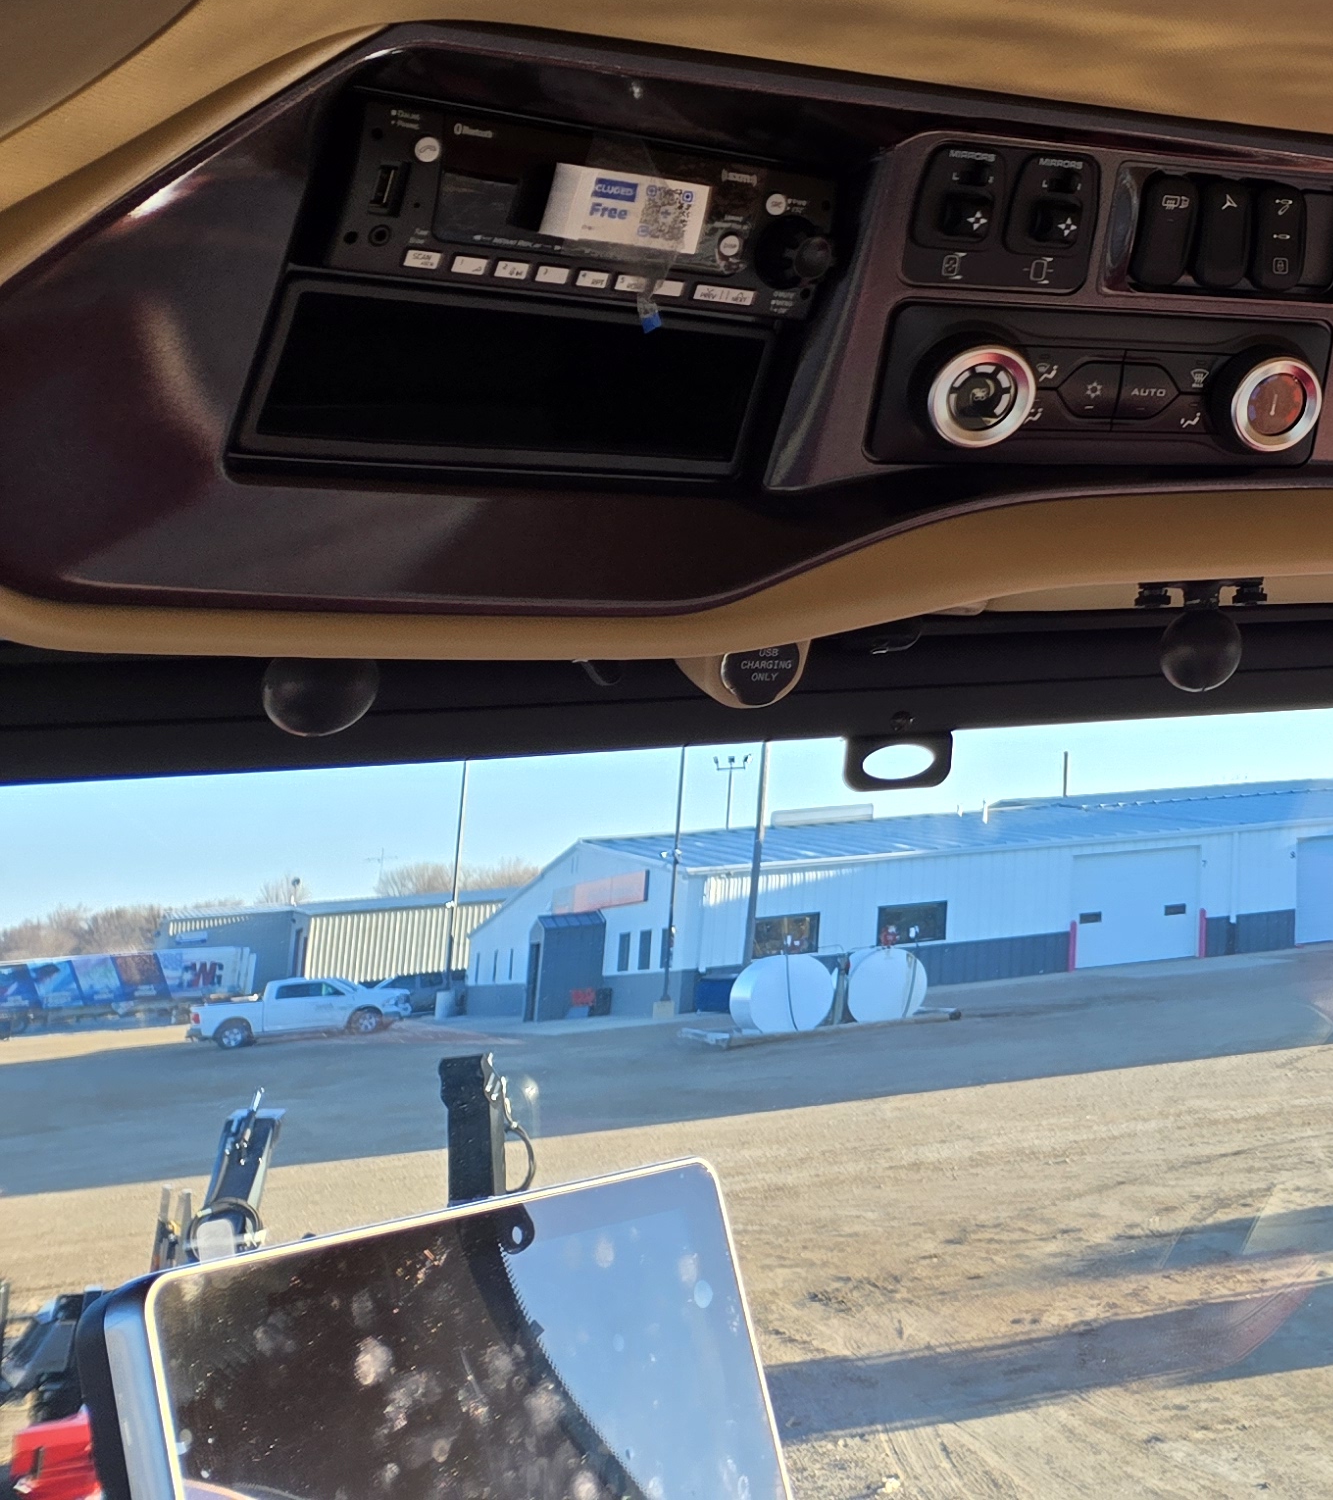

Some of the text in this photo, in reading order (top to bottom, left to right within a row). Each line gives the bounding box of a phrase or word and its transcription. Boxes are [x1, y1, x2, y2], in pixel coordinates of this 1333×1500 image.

[949, 150, 996, 162] MIRRORS
[1039, 158, 1083, 170] MIRRORS
[589, 202, 628, 220] Free
[412, 252, 432, 262] SCAN
[1131, 387, 1167, 397] AUTO
[759, 648, 779, 657] USB
[741, 660, 792, 670] CHARGING
[751, 672, 779, 682] ONLY
